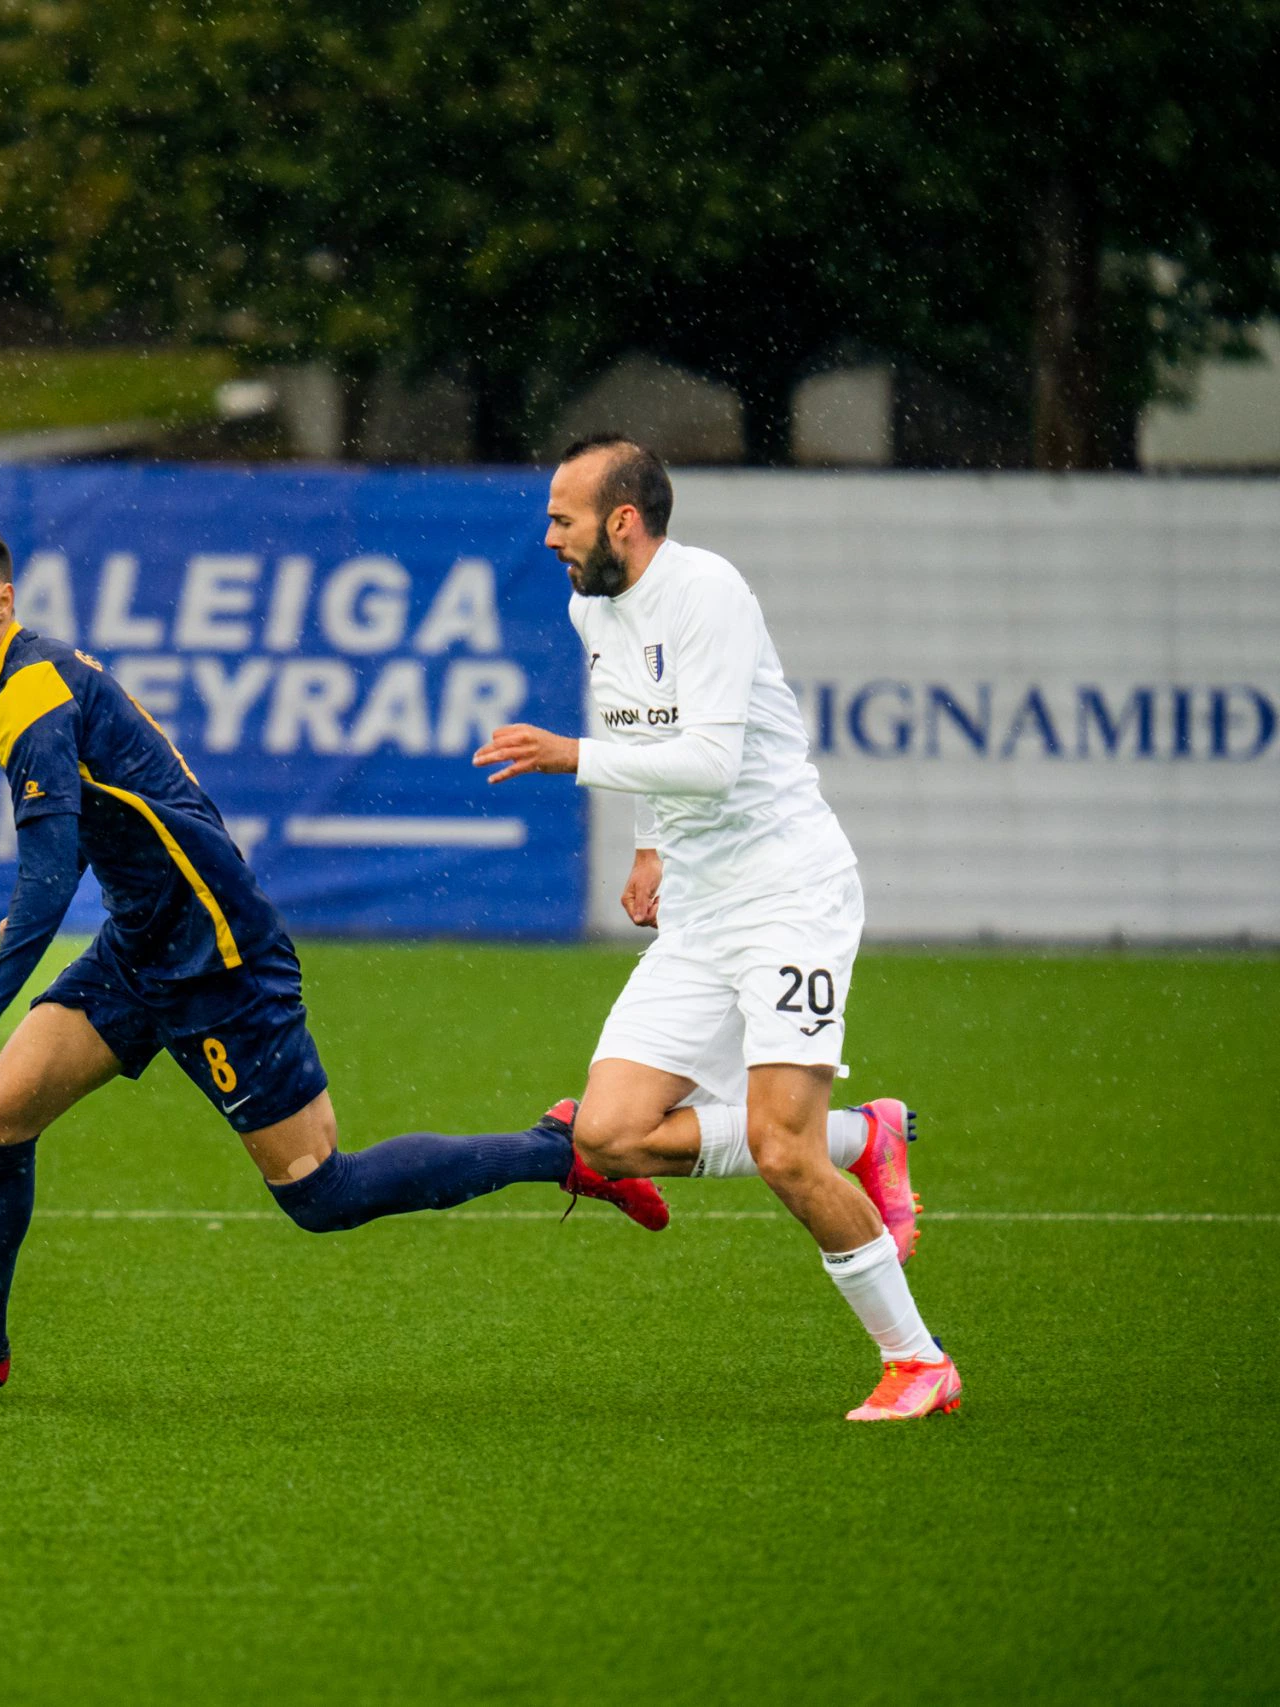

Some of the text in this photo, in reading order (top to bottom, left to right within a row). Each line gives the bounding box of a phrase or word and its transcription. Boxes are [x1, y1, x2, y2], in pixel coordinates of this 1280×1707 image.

[10, 551, 505, 655] ALEIGA
[776, 965, 836, 1016] 20
[203, 1037, 238, 1093] 8
